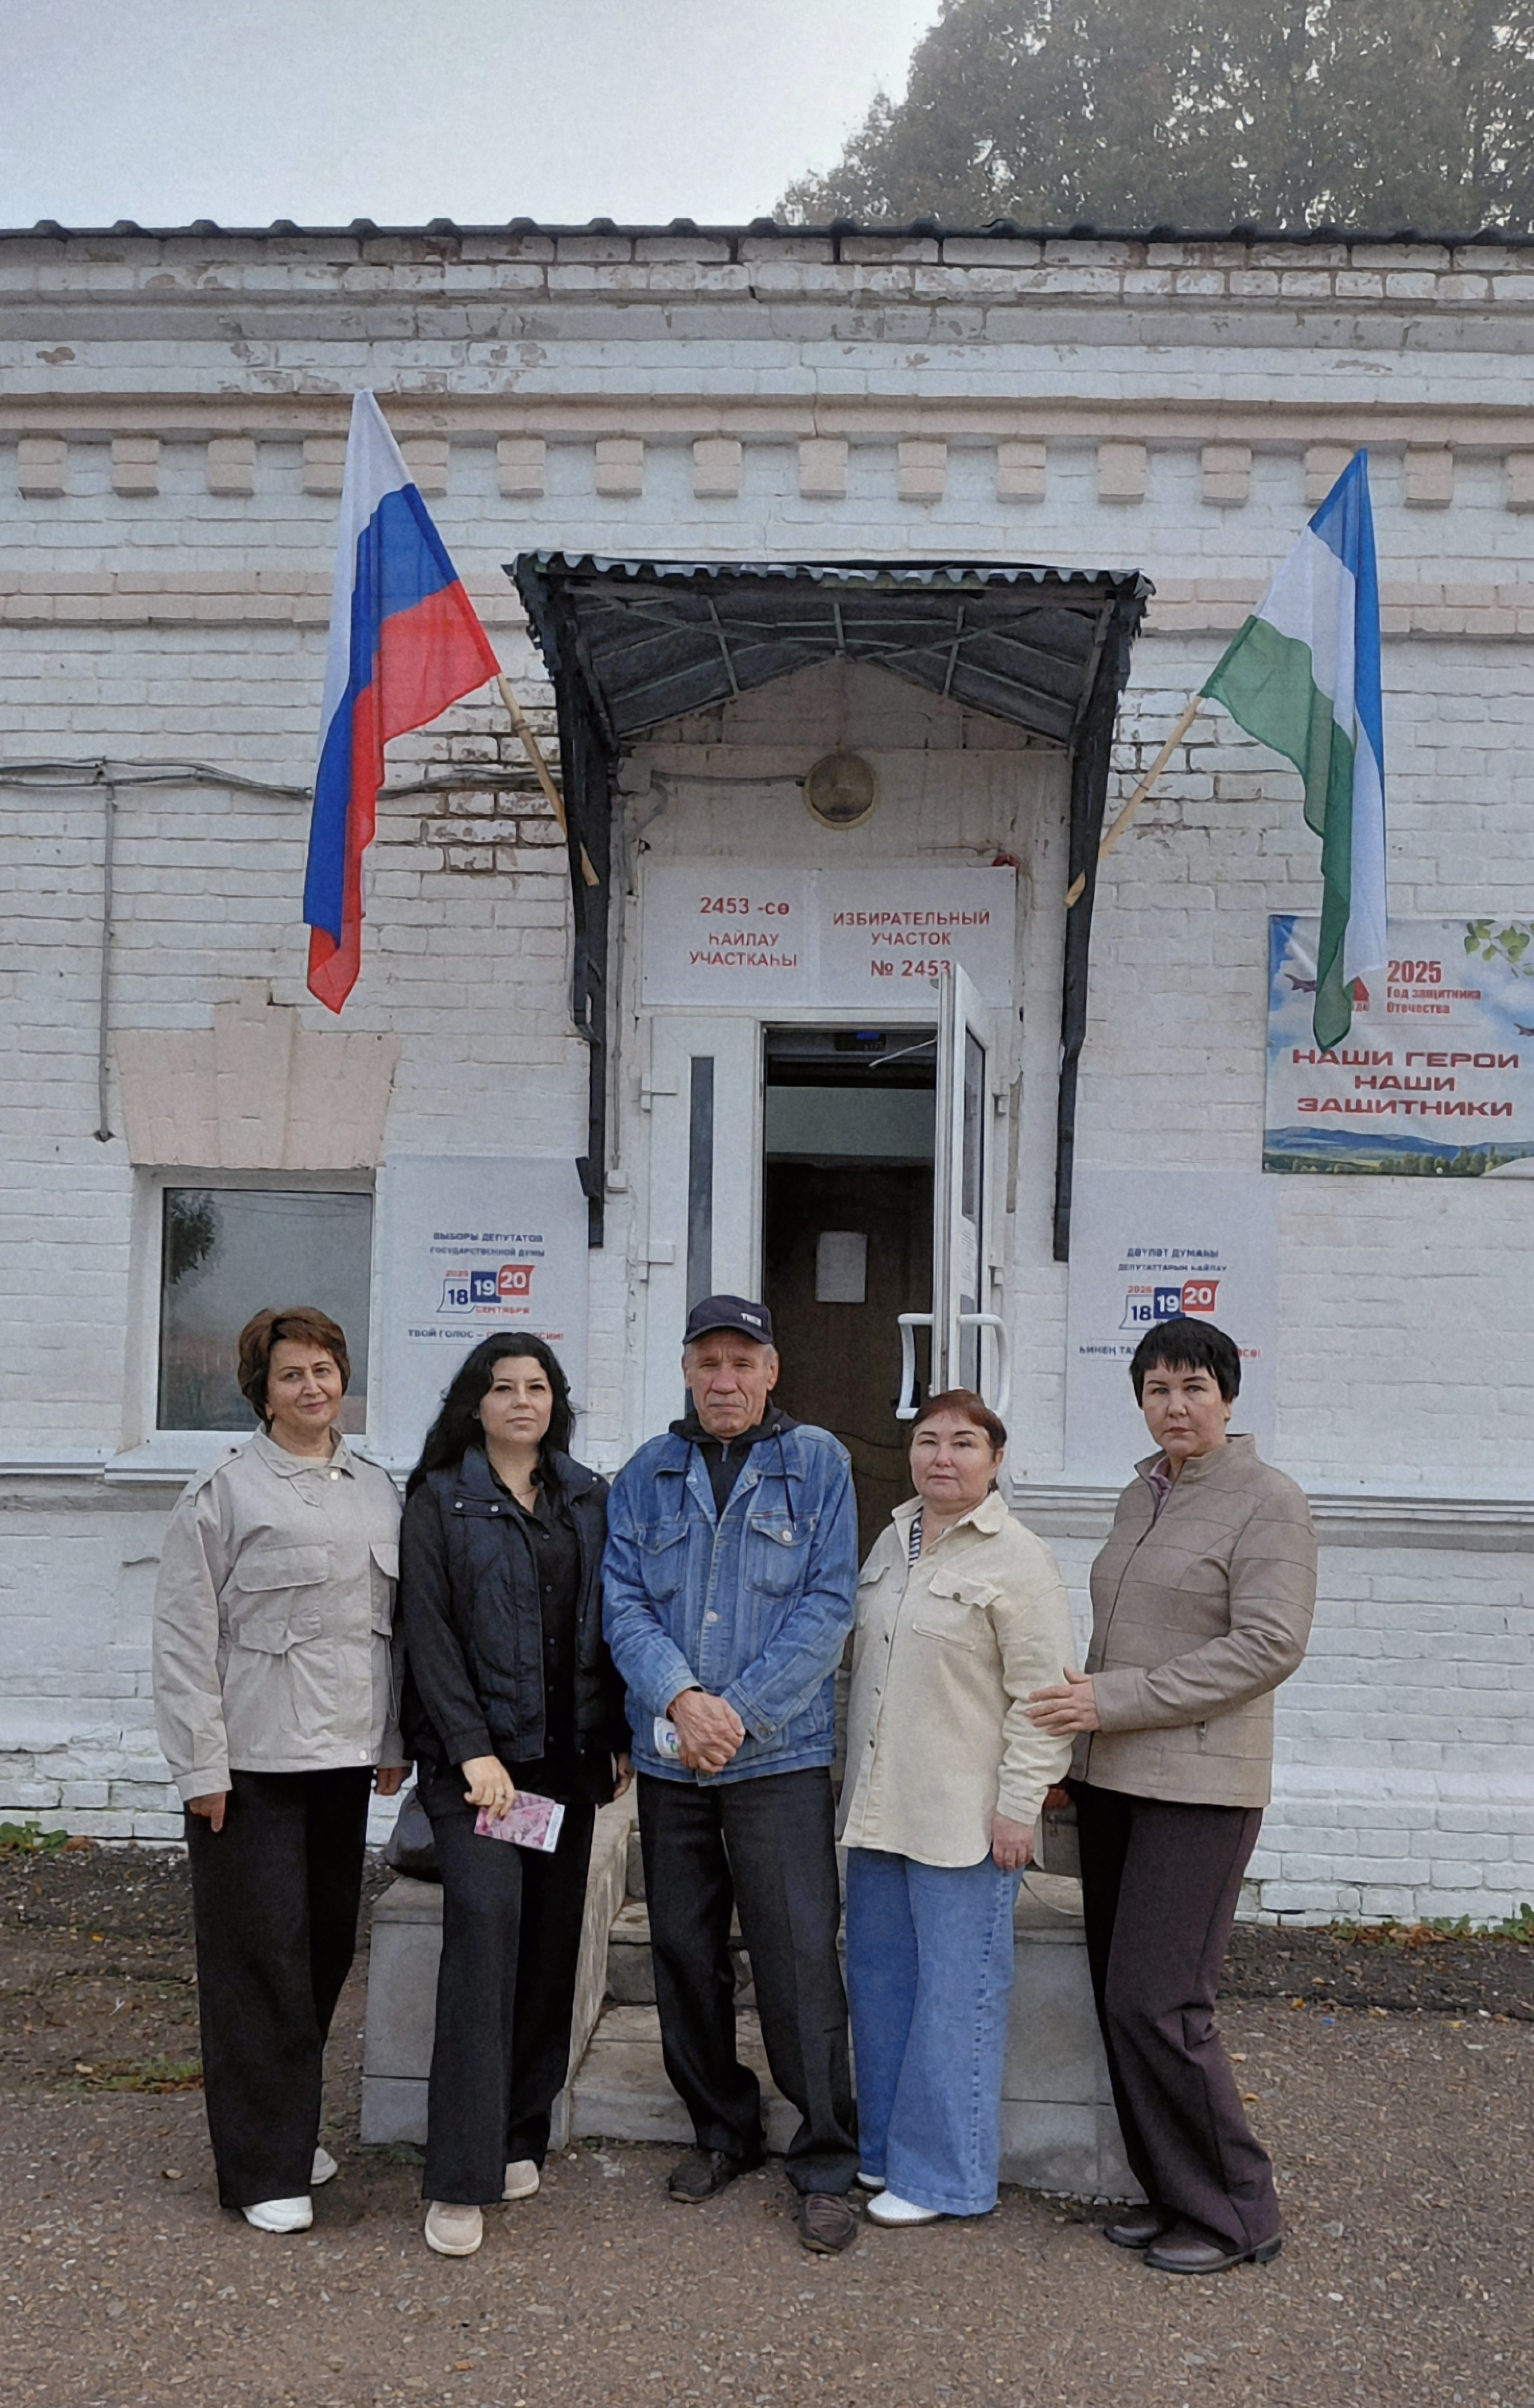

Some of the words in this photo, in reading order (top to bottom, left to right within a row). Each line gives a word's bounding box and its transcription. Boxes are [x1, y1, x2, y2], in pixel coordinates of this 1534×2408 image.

[700, 897, 750, 914] 2453
[833, 908, 990, 925] ИЗБИРАТЕЛЬНЫЙ
[871, 932, 951, 945] УЧАСТОК
[871, 960, 894, 976] №
[901, 959, 951, 977] 2453
[1386, 959, 1442, 984] 2025
[1387, 986, 1409, 1000] Год
[1412, 989, 1481, 1001] защитника
[1386, 1002, 1450, 1014] Отечества
[1293, 1049, 1393, 1066] НАШИ
[1406, 1052, 1519, 1068] ГЕРОИ
[1354, 1075, 1455, 1091] НАШИ
[433, 1233, 478, 1241] ВЫБОРЫ
[482, 1233, 543, 1243] ДЕПУТАТОВ
[447, 1289, 468, 1305] 18
[474, 1280, 495, 1296] 19
[500, 1271, 526, 1290] 20
[1131, 1305, 1151, 1321] 18
[1157, 1295, 1179, 1313] 19
[1185, 1287, 1212, 1305] 20
[408, 1328, 436, 1337] ТВОЙ
[439, 1330, 474, 1338] ГОЛОС
